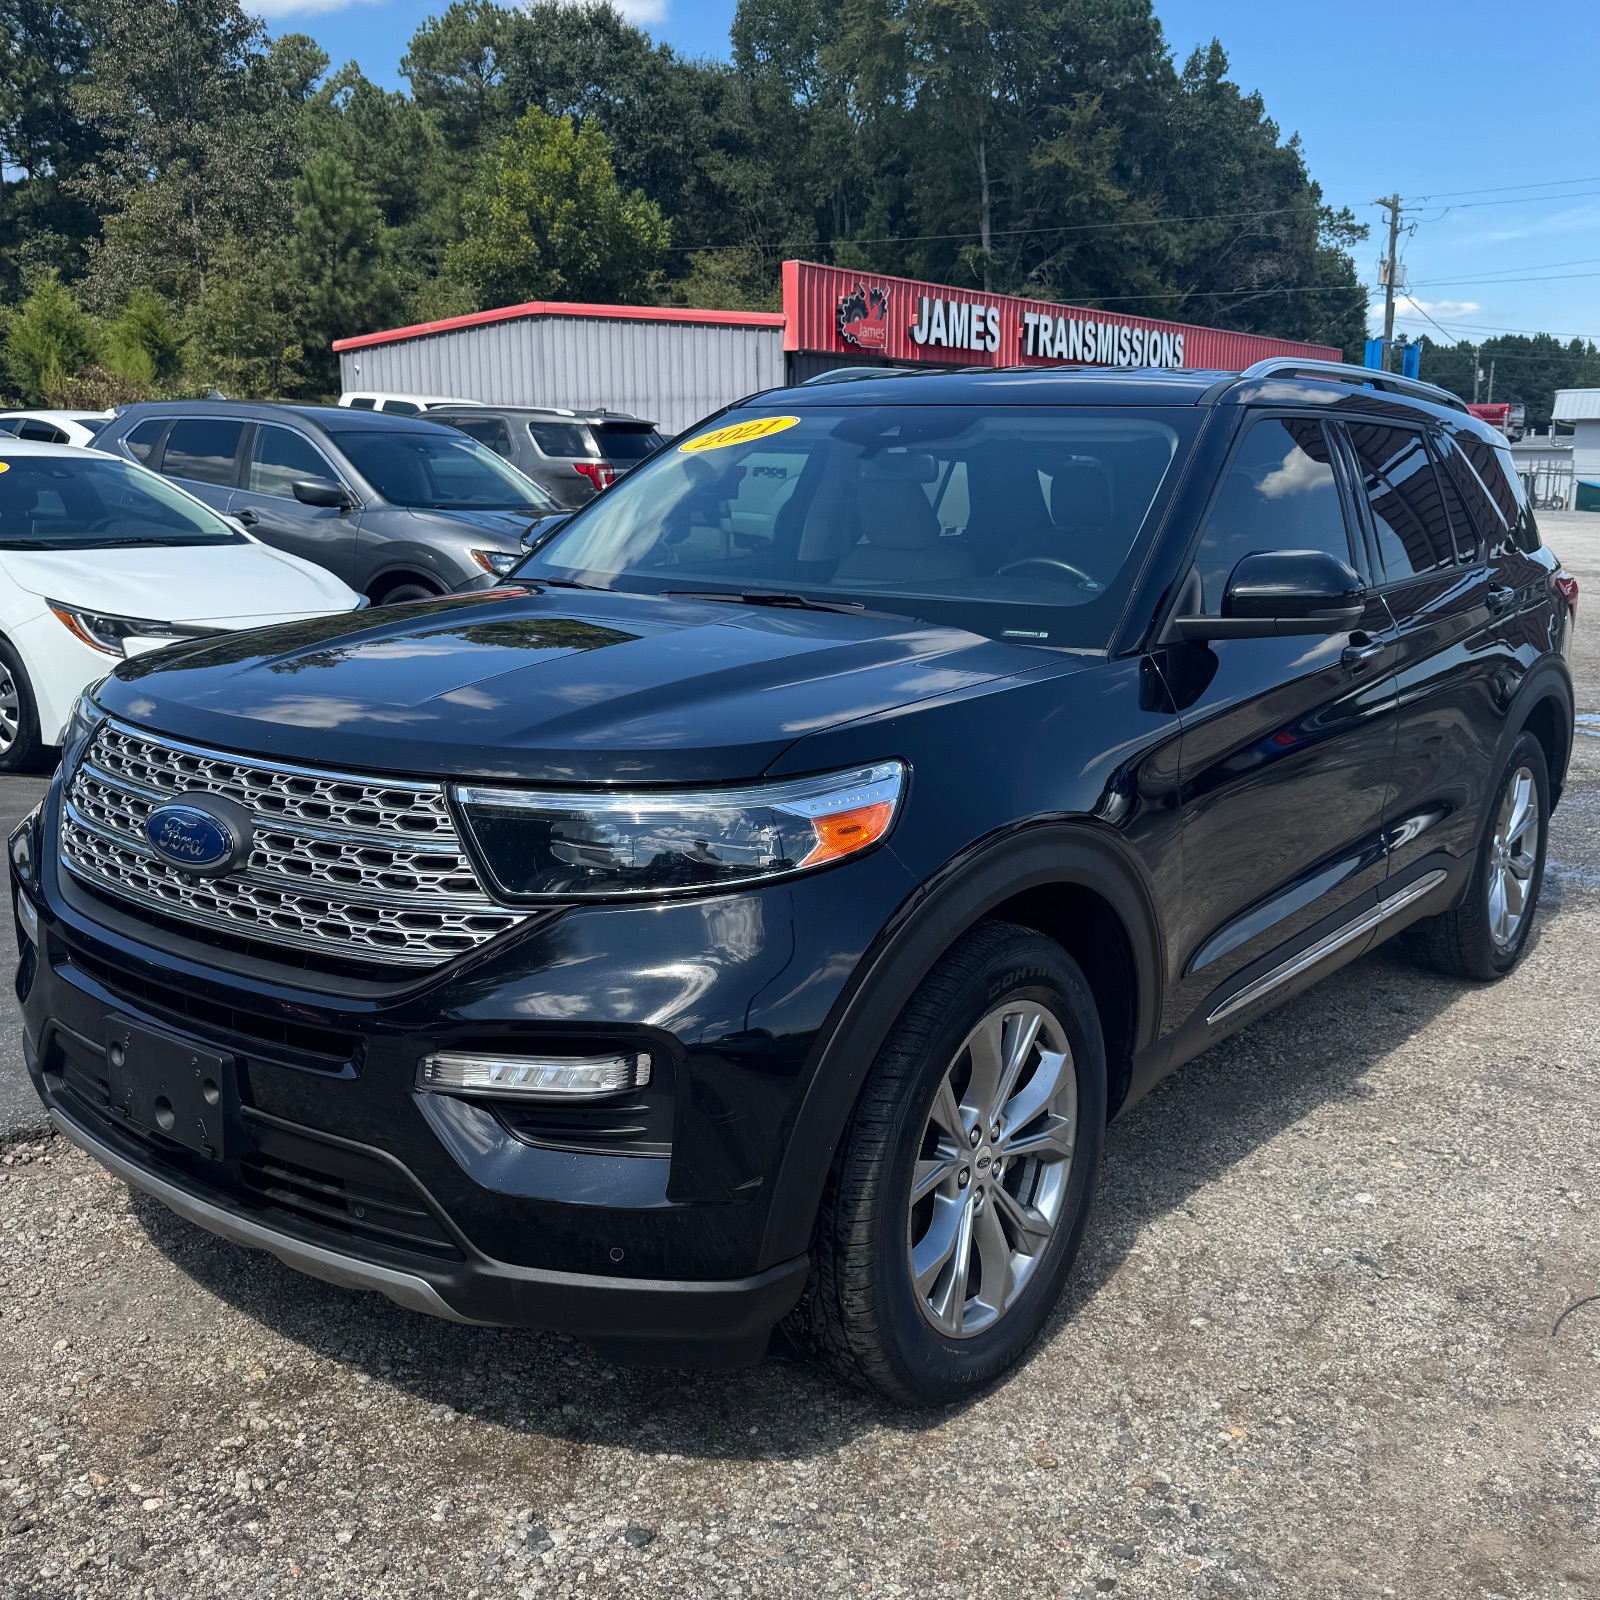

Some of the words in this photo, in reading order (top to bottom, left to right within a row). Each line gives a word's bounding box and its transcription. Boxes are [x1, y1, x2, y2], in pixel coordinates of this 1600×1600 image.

[858, 322, 885, 340] James
[913, 296, 1000, 352] JAMES
[1024, 312, 1184, 368] TRANSMISSIONS
[693, 419, 783, 449] 2021
[158, 816, 208, 856] Ford
